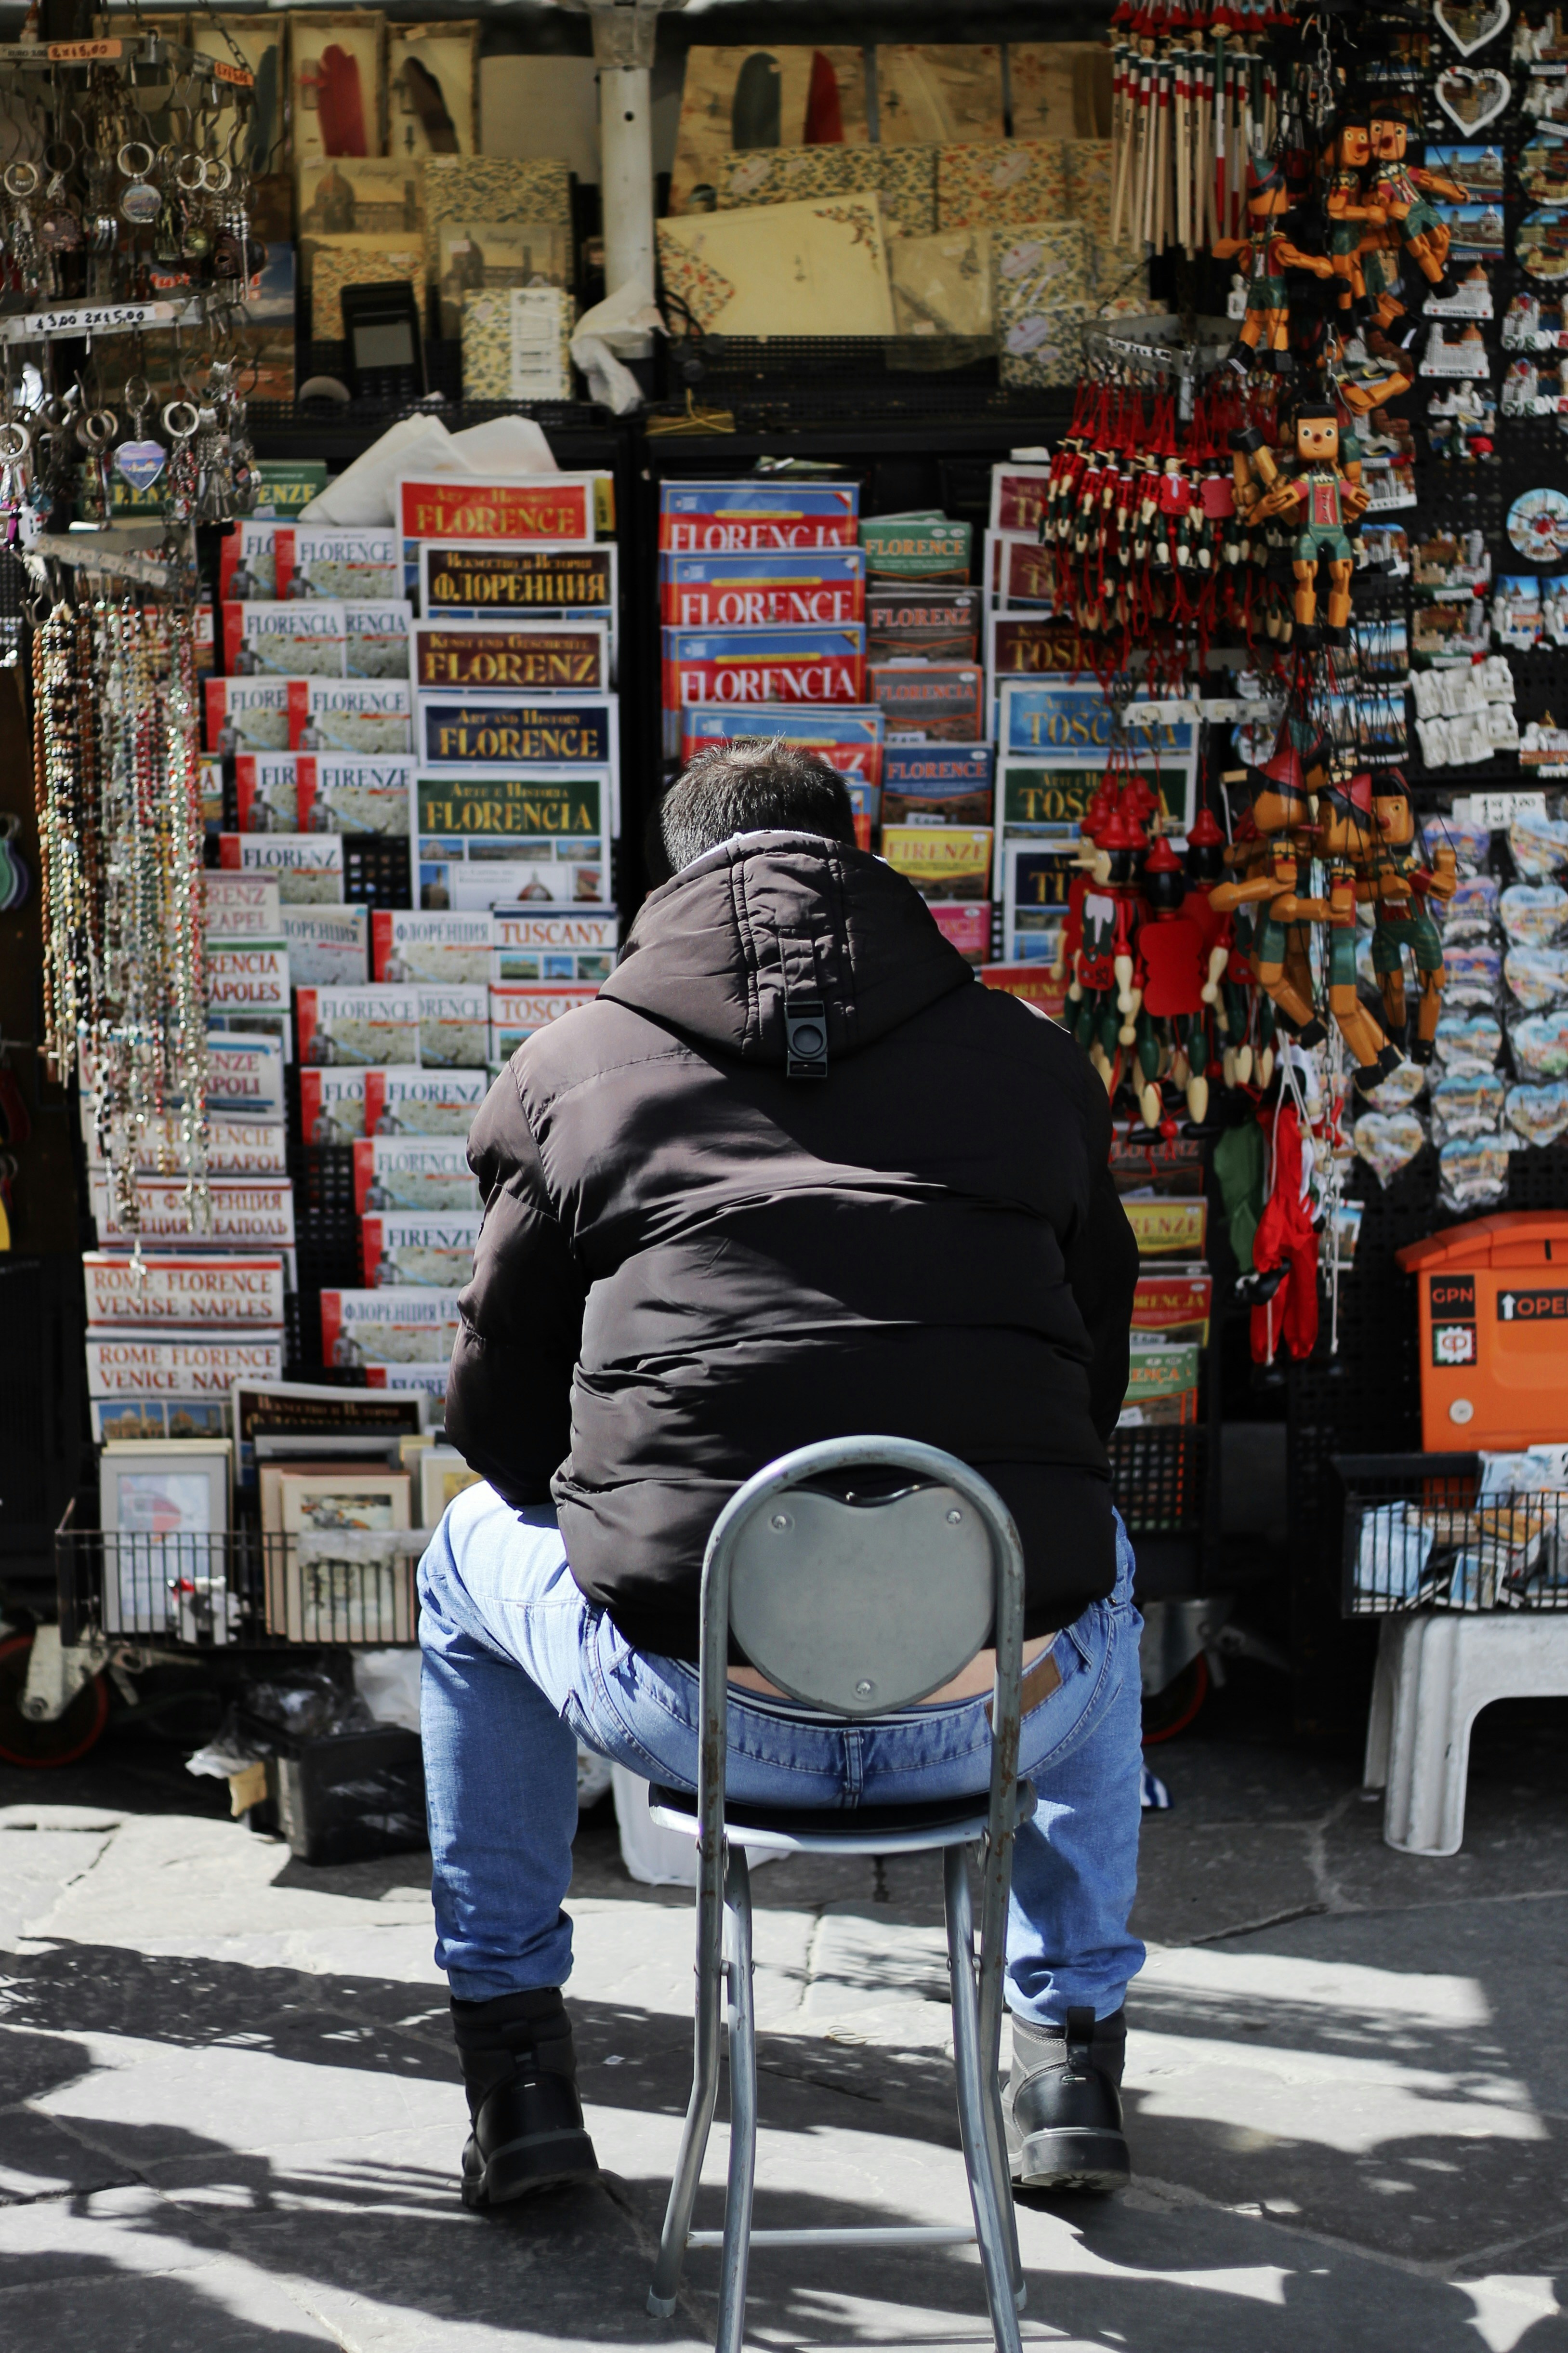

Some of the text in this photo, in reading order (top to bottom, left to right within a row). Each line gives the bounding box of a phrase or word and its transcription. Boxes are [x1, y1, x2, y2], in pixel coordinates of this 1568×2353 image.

[416, 503, 576, 538] FLORENCE
[300, 541, 393, 562] FLORENCE
[865, 539, 965, 556] FLORENCE
[434, 572, 606, 604] ФЛОРЕНЦИЯ
[680, 591, 852, 625] FLORENCE
[871, 608, 971, 628] FLORENZ
[246, 614, 339, 635] FLORENCIA
[424, 652, 596, 685] FLORENZ
[680, 667, 856, 703] FLORENCIA
[875, 684, 975, 701] FLORENCIA
[312, 691, 405, 712] FLORENCE
[439, 727, 599, 760] FLORENCE
[322, 768, 410, 787] FIRENZE
[887, 761, 987, 780] FLORENCE
[426, 801, 593, 833] FLORENCIA
[244, 848, 337, 868] FLORENZ
[887, 841, 985, 860] FIRENZE
[396, 923, 489, 942] ФЛОРЕНЦИЯ
[500, 922, 608, 945] TUSCANY
[322, 1000, 414, 1019] FLORENCE
[389, 1083, 482, 1102] FLORENZ
[388, 1229, 475, 1248] FIRENZE
[93, 1270, 273, 1293] ROME FLORENCE
[1432, 1286, 1474, 1304] GPN
[1517, 1295, 1568, 1316] OPE
[95, 1295, 273, 1318] VENISE NAPLES
[344, 1303, 437, 1322] ФЛОРЕНЦИЯ
[99, 1345, 277, 1367] ROME FLORENCE
[100, 1370, 181, 1389] VENICE
